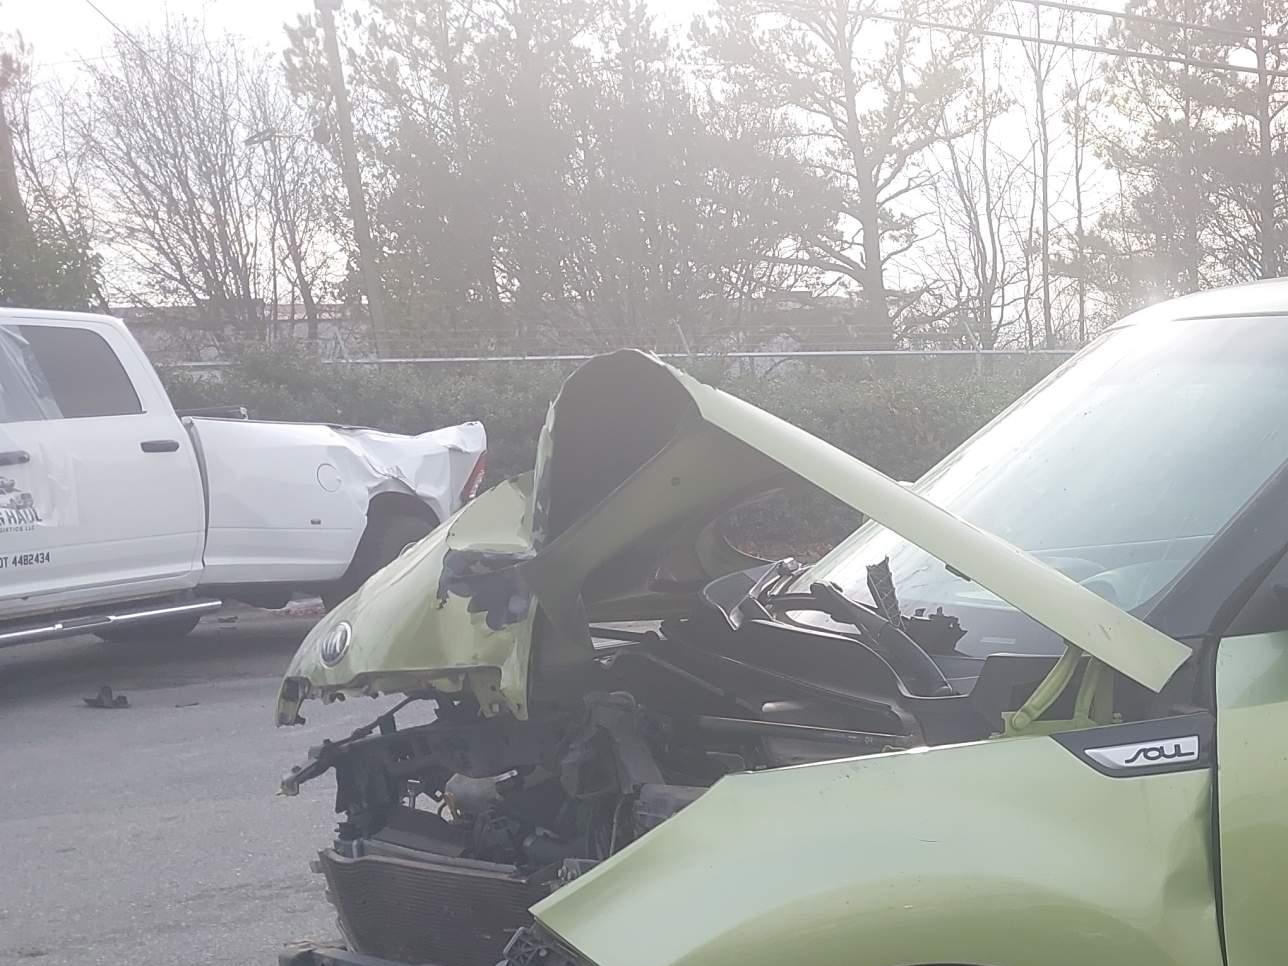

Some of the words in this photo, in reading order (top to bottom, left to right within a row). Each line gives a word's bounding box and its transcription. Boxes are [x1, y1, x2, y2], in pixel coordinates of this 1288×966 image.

[4, 508, 43, 525] HAUL
[12, 551, 50, 568] 4482434
[1124, 743, 1195, 764] SOUL
